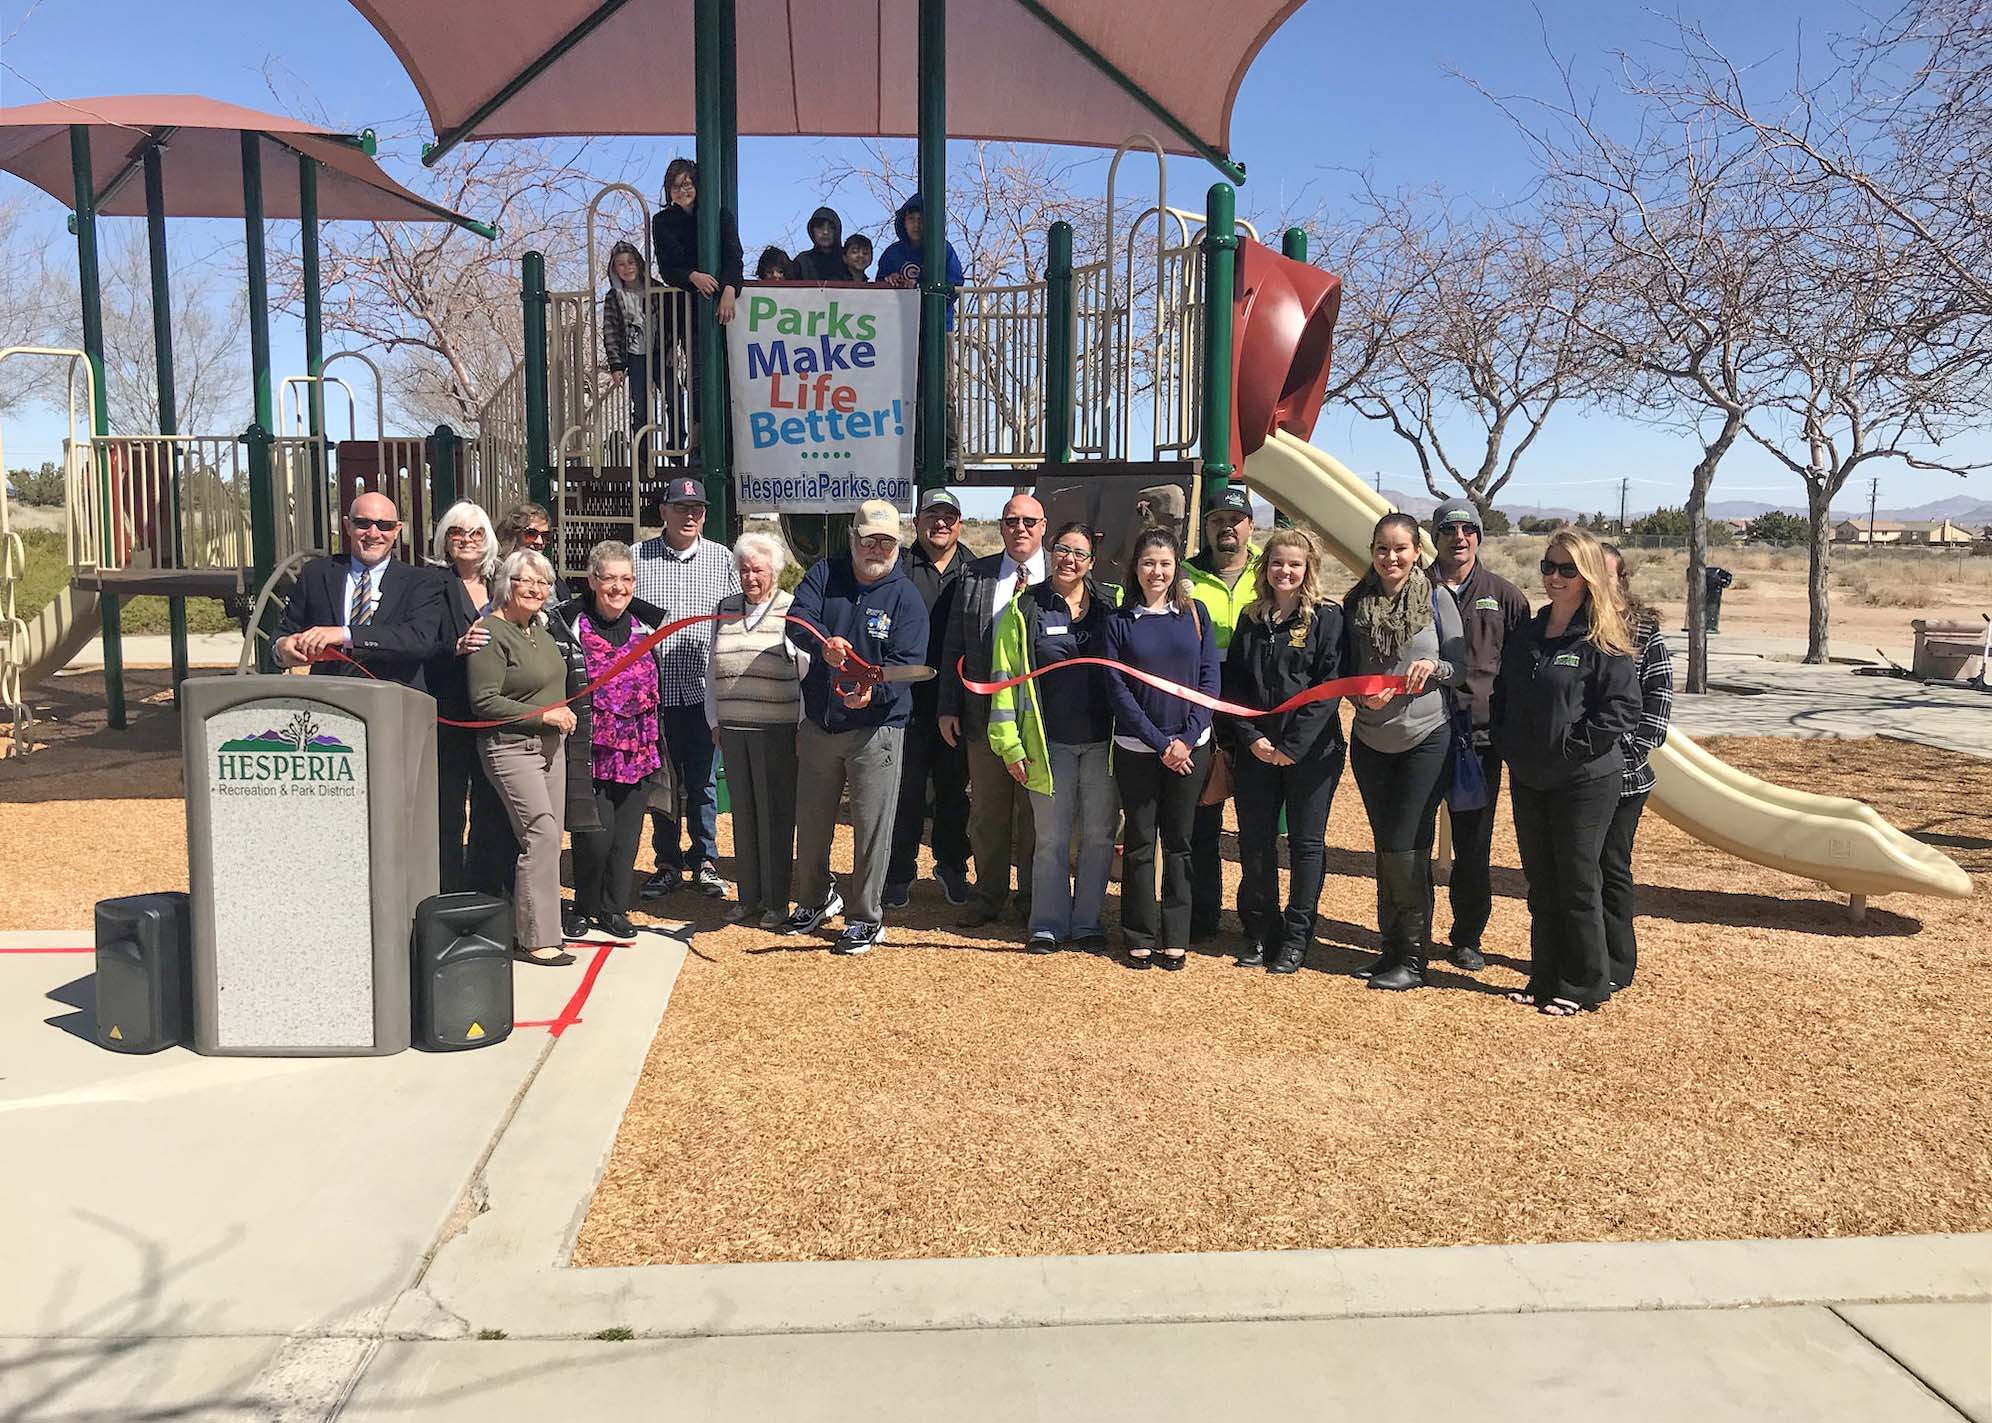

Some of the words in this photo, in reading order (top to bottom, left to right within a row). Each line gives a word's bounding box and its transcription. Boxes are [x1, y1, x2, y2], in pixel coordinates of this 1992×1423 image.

[748, 296, 877, 341] Parks
[747, 335, 876, 380] Make
[770, 371, 857, 413] Life
[750, 399, 904, 449] Better!
[740, 473, 910, 504] HesperiaParks.com
[217, 755, 355, 781] HESPERIA
[218, 784, 277, 797] Recreation
[279, 784, 288, 797] &
[291, 785, 316, 797] Park
[318, 785, 355, 797] District
